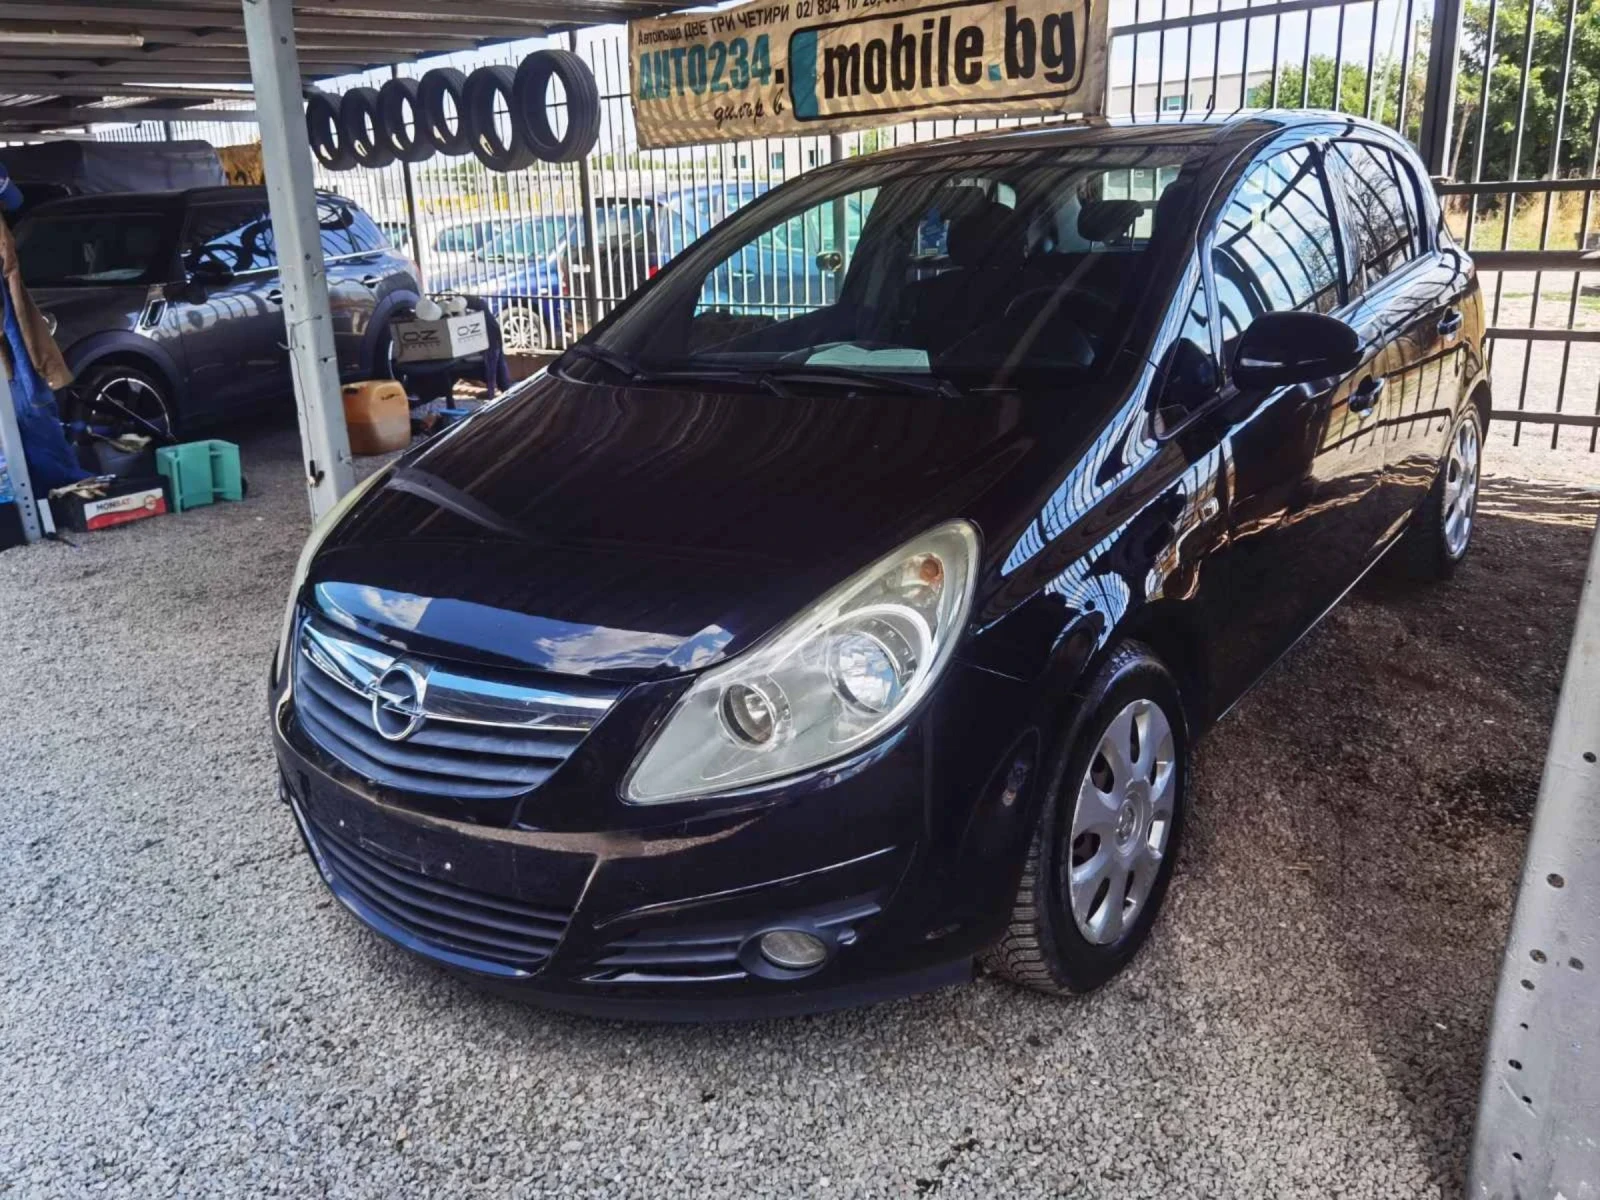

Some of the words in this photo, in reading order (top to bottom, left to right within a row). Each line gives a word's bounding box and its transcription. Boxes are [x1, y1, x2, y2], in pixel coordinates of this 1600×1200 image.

[684, 22, 708, 41] ДВЕ
[710, 15, 736, 33] ТРИ
[738, 4, 790, 28] ЧЕТИРИ
[823, 6, 1077, 100] mobile.bg
[403, 329, 438, 342] OZ
[457, 323, 481, 336] OZ
